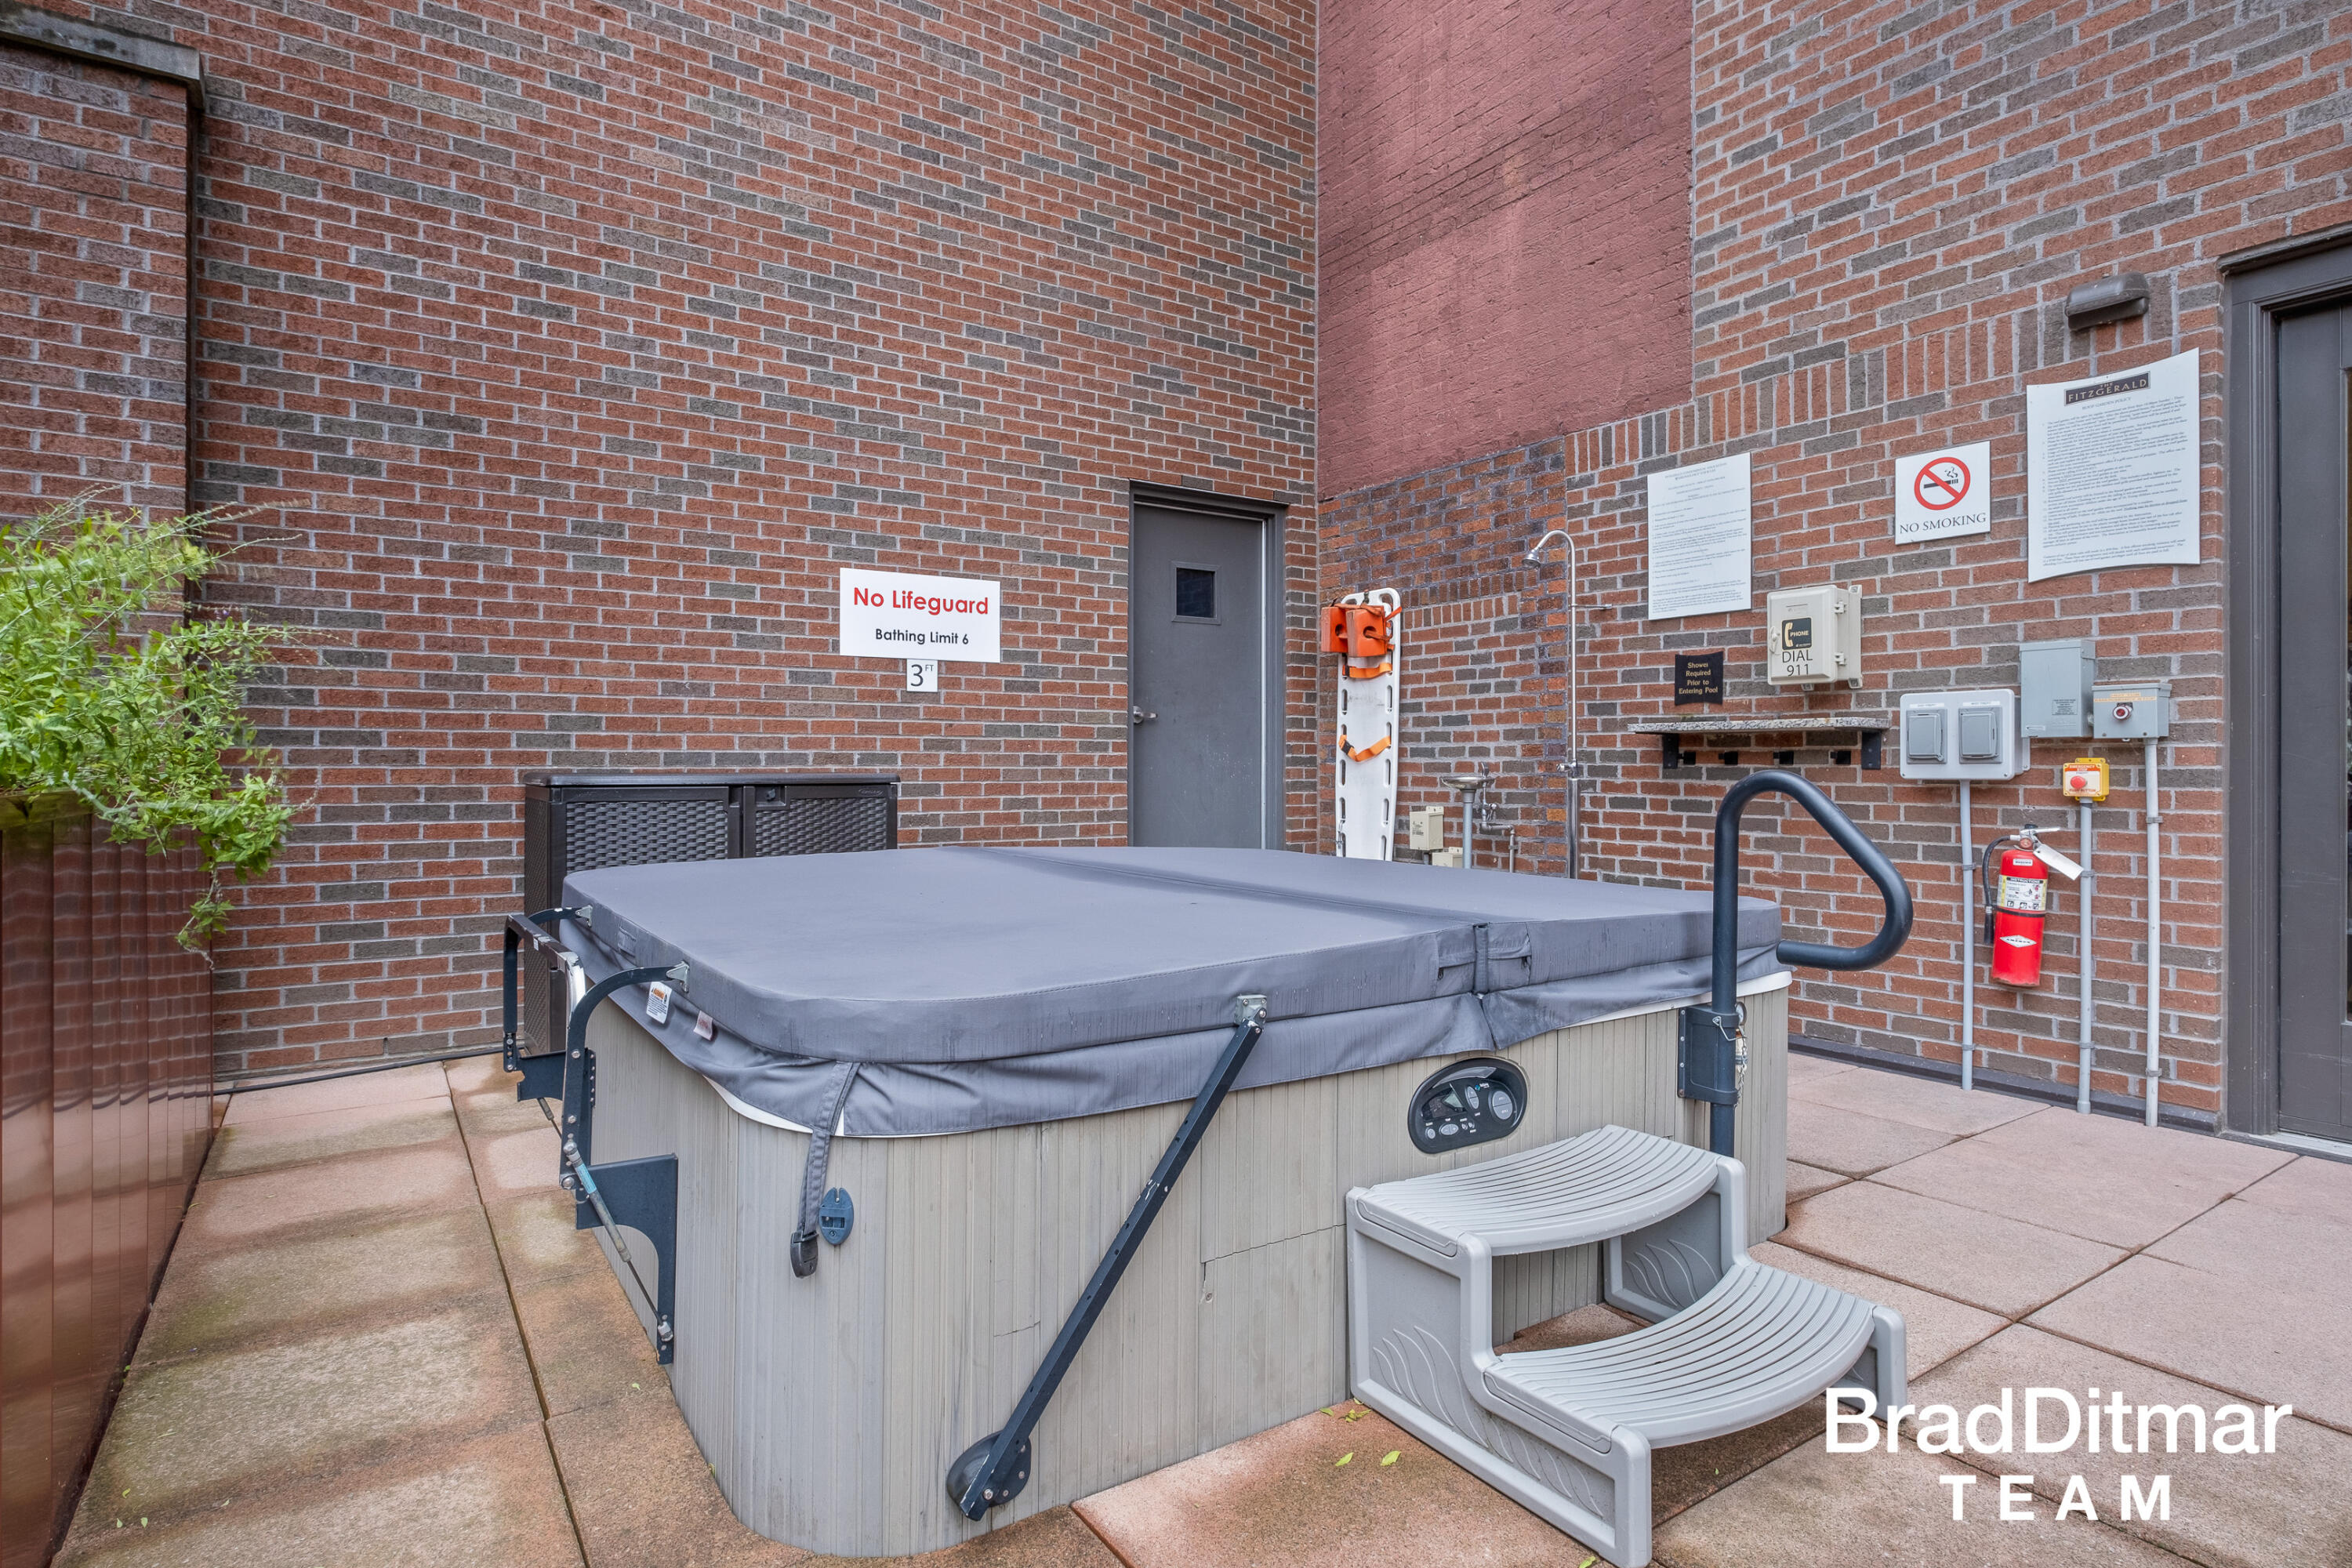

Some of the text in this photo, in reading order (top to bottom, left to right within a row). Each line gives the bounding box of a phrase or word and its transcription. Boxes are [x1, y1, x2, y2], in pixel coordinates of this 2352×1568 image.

[2068, 379, 2147, 402] FITZGERALD
[1900, 513, 1986, 534] NO SMOKING
[854, 587, 989, 615] No Lifeguard
[875, 628, 969, 645] Bathing Limit 6
[1782, 649, 1813, 664] DIAL
[910, 664, 924, 687] 3
[1686, 669, 1711, 678] Required
[1787, 663, 1809, 677] 911
